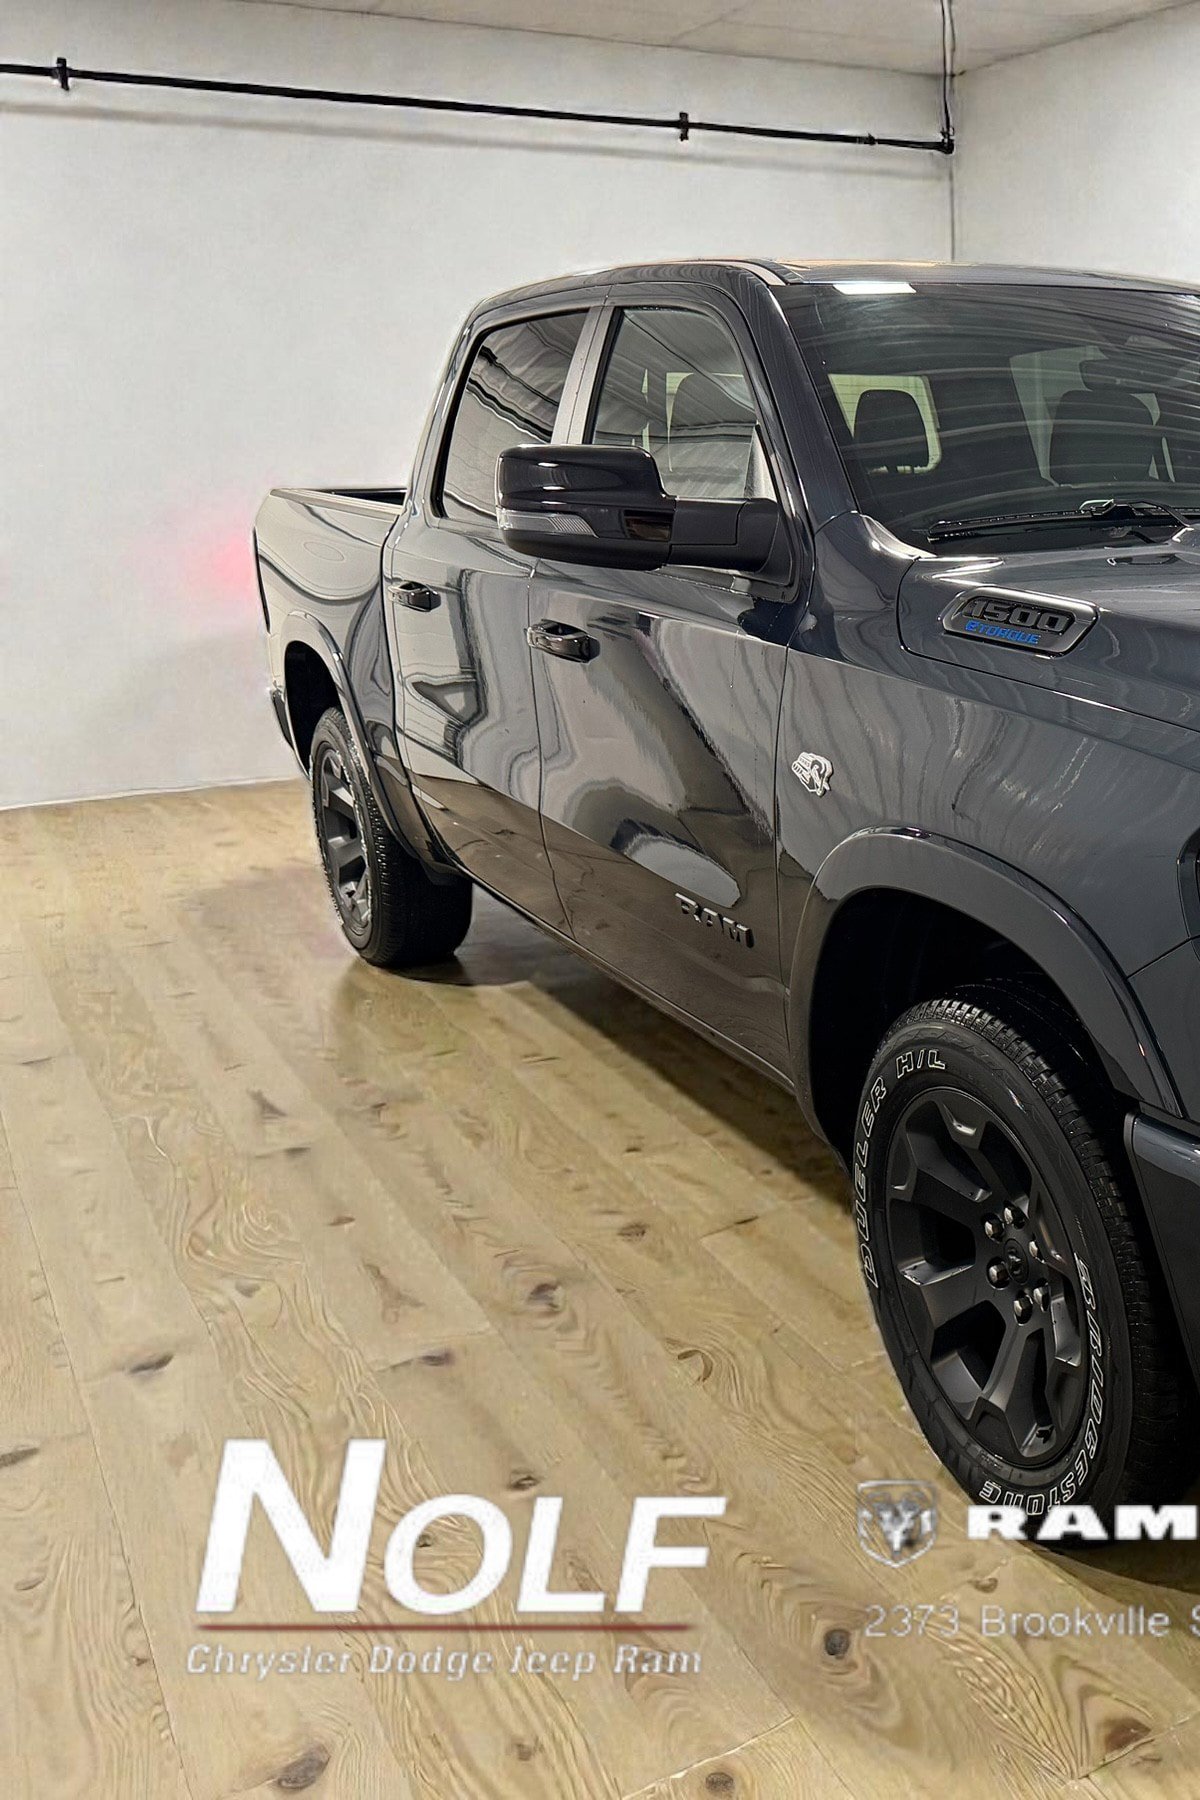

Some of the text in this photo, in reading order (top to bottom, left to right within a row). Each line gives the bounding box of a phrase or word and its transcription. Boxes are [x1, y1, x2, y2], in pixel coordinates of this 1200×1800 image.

[962, 598, 1071, 634] 1500
[964, 619, 1041, 646] eTORQUE
[674, 892, 755, 949] RAM
[852, 1048, 946, 1289] DUELER H/L
[978, 1252, 1106, 1516] BRIDGESTONE
